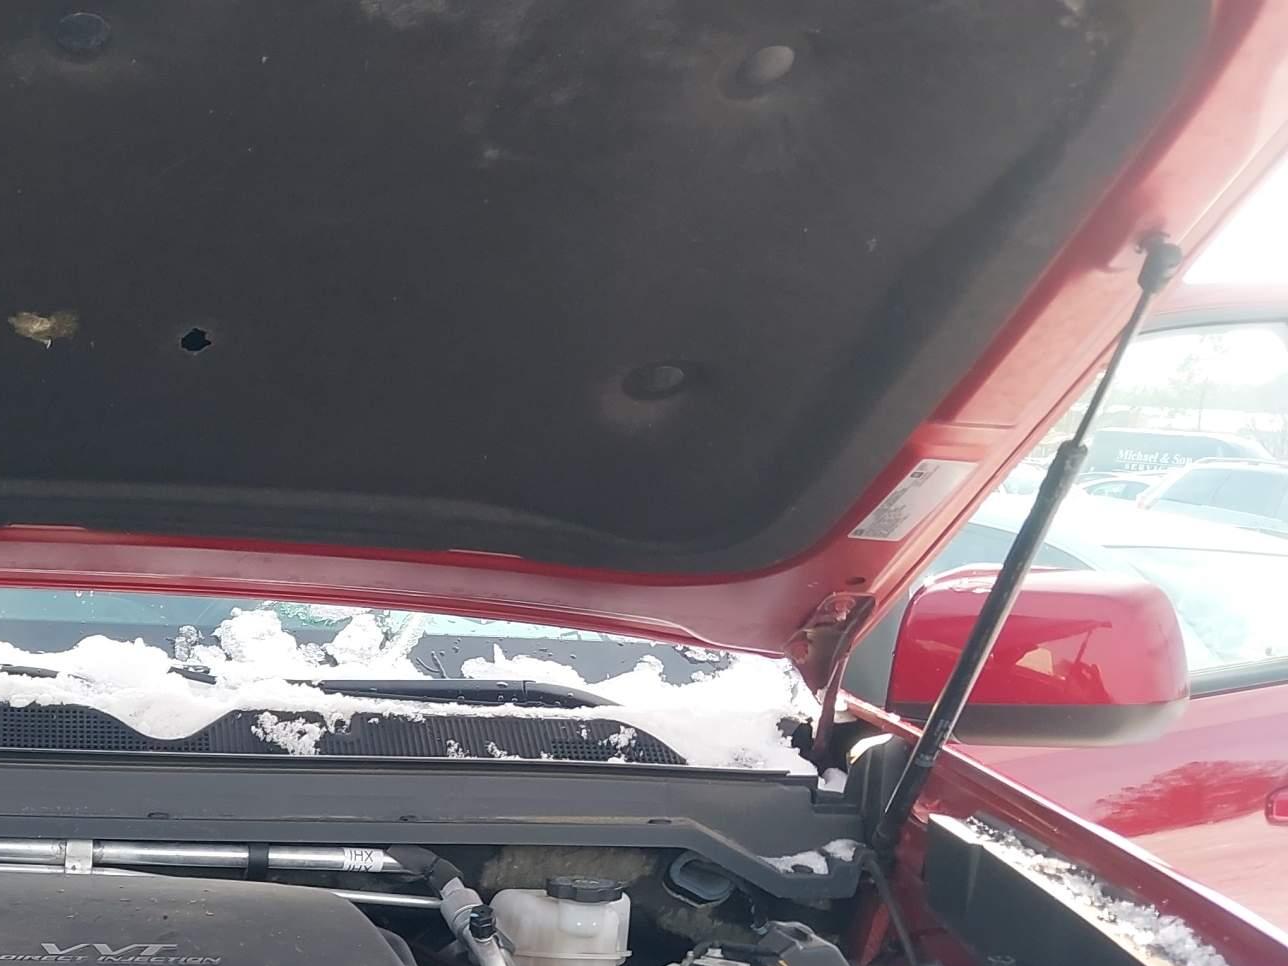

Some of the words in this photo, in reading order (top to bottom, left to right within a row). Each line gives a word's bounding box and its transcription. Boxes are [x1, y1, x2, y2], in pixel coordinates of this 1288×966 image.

[1116, 449, 1160, 463] Michael
[1160, 452, 1170, 464] &
[40, 942, 179, 956] VVT
[96, 955, 223, 966] INJECTION
